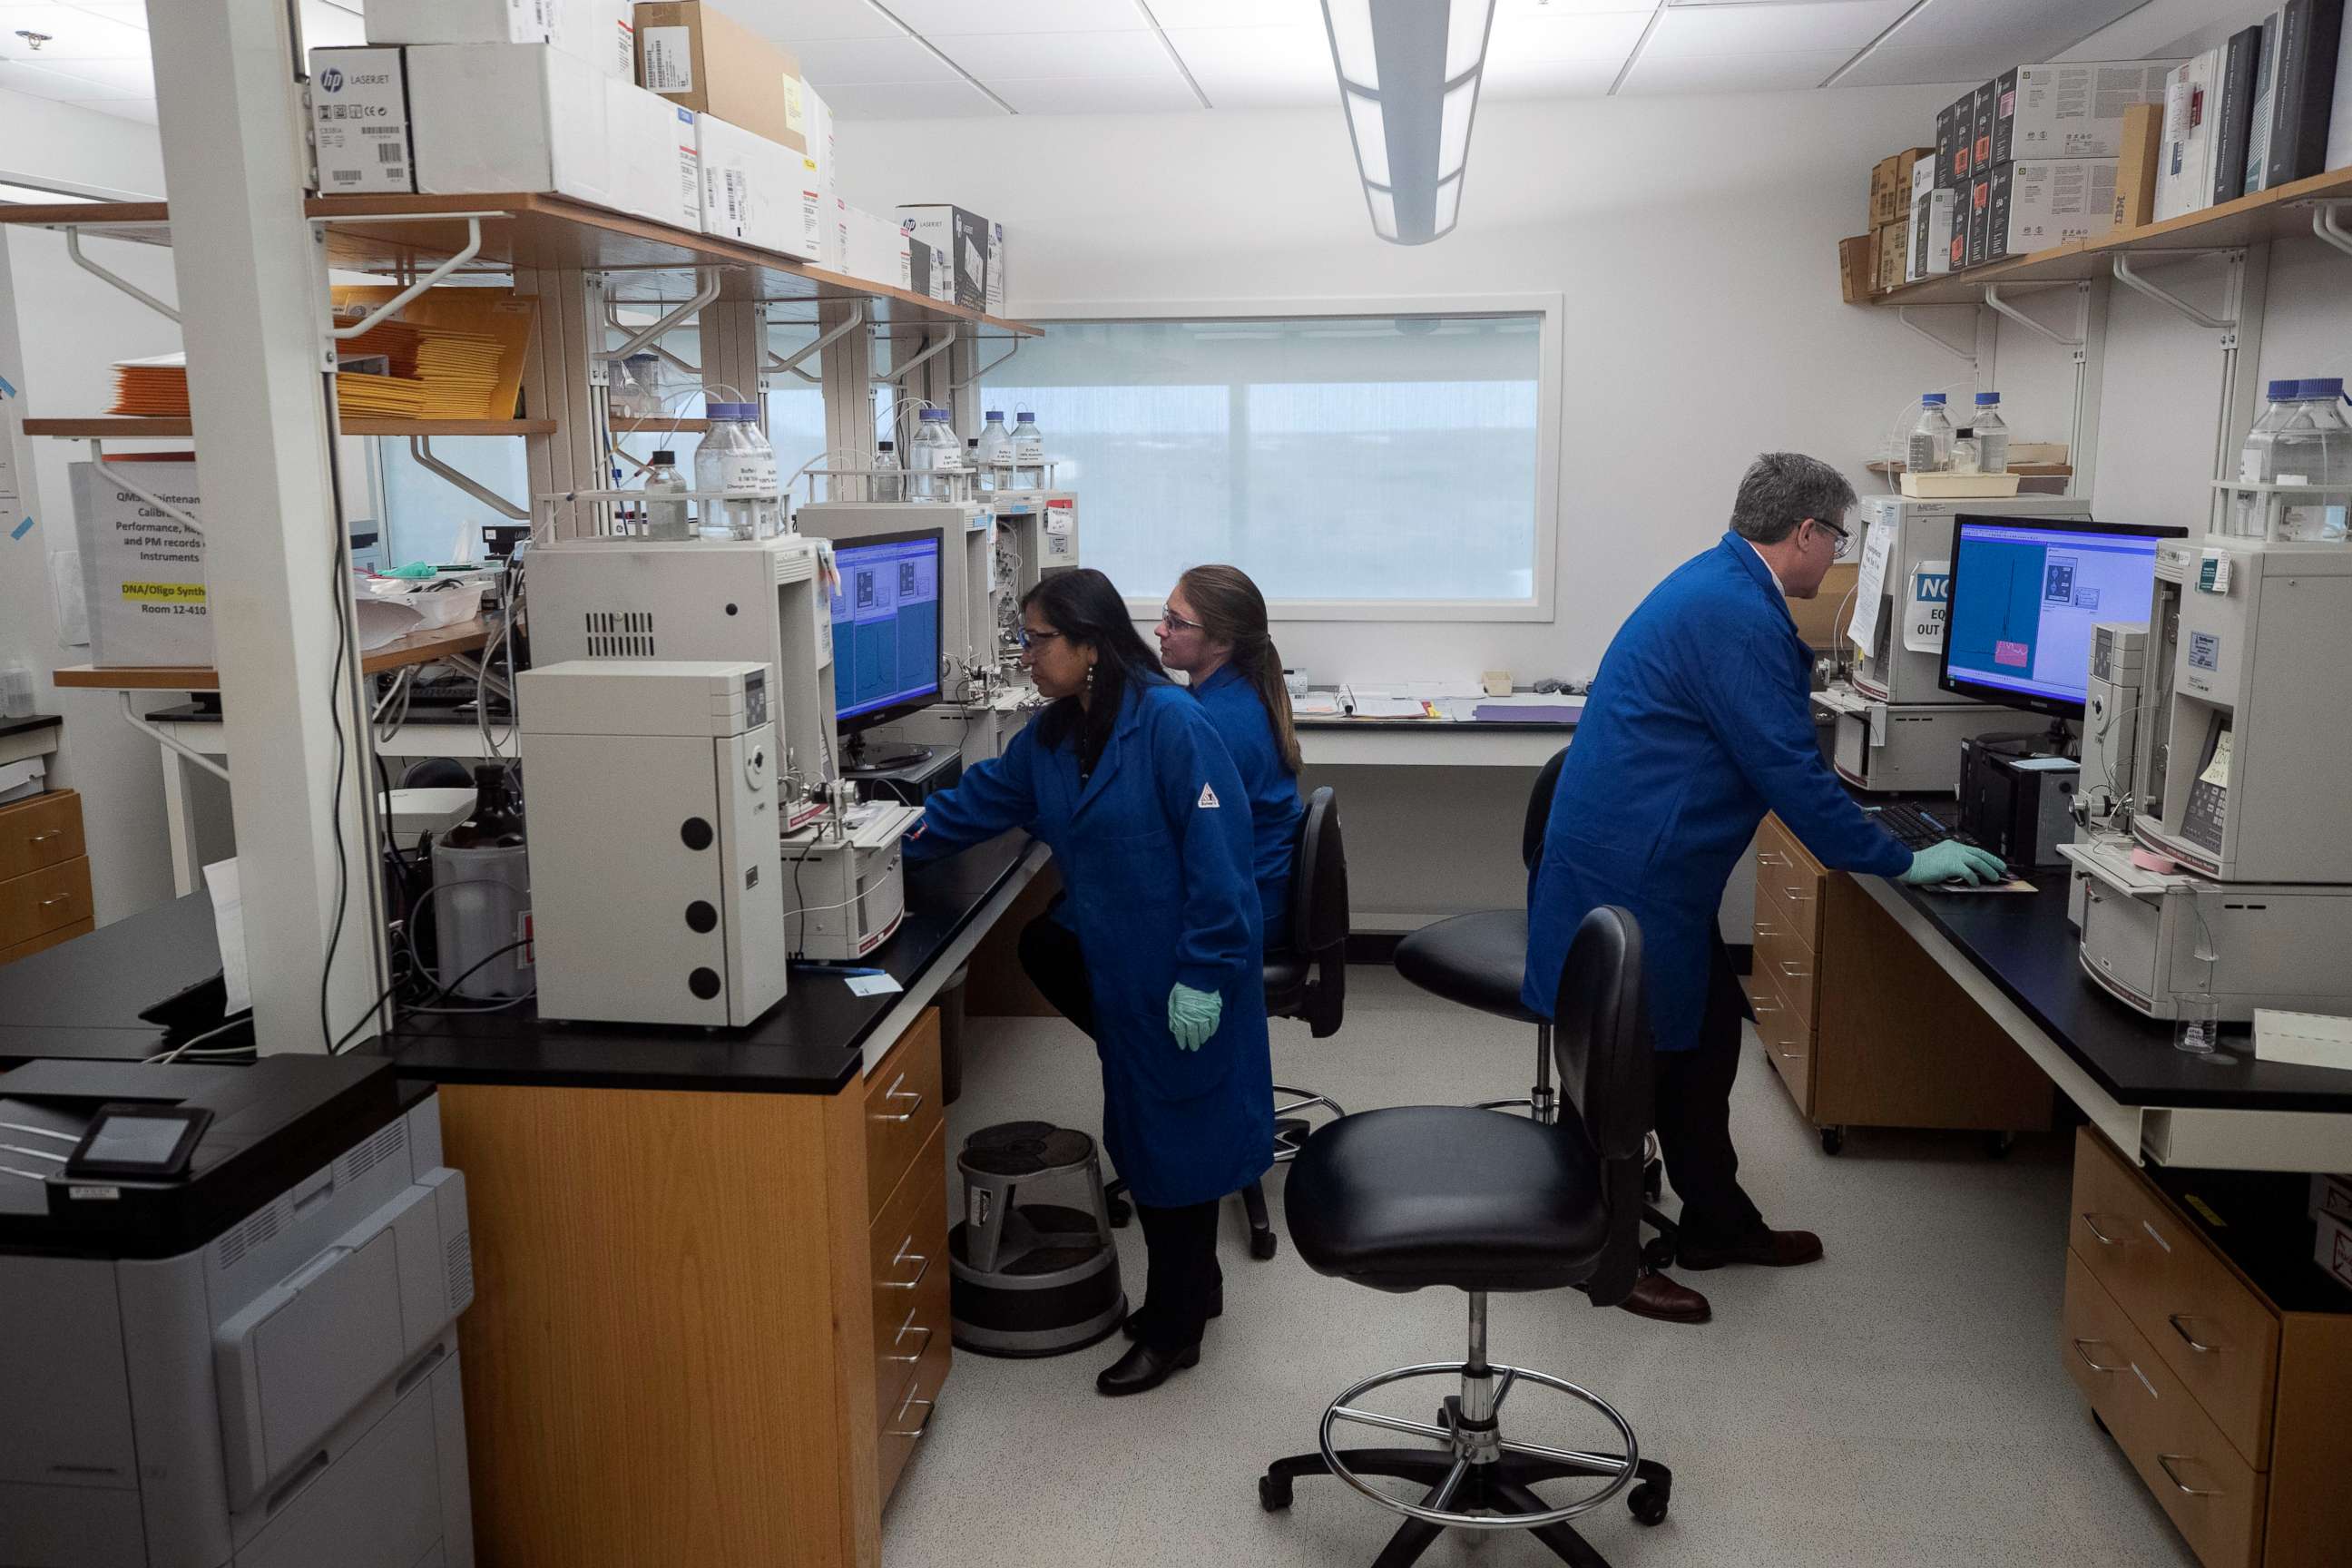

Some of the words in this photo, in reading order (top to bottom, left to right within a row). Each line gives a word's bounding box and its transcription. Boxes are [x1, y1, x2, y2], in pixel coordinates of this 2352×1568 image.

[321, 67, 343, 93] hp
[350, 74, 388, 84] LASERJET
[2114, 195, 2125, 224] IBM
[152, 494, 201, 505] intenan
[116, 521, 181, 534] Performance,
[123, 536, 142, 545] and
[145, 537, 162, 546] PM
[164, 540, 201, 548] records
[141, 551, 200, 563] Instruments
[122, 583, 175, 597] DNA/Oligo
[177, 585, 205, 597] Synth
[142, 604, 171, 614] Room
[173, 605, 206, 616] 12-410
[1931, 609, 1945, 622] EQ
[1917, 623, 1940, 636] OUT
